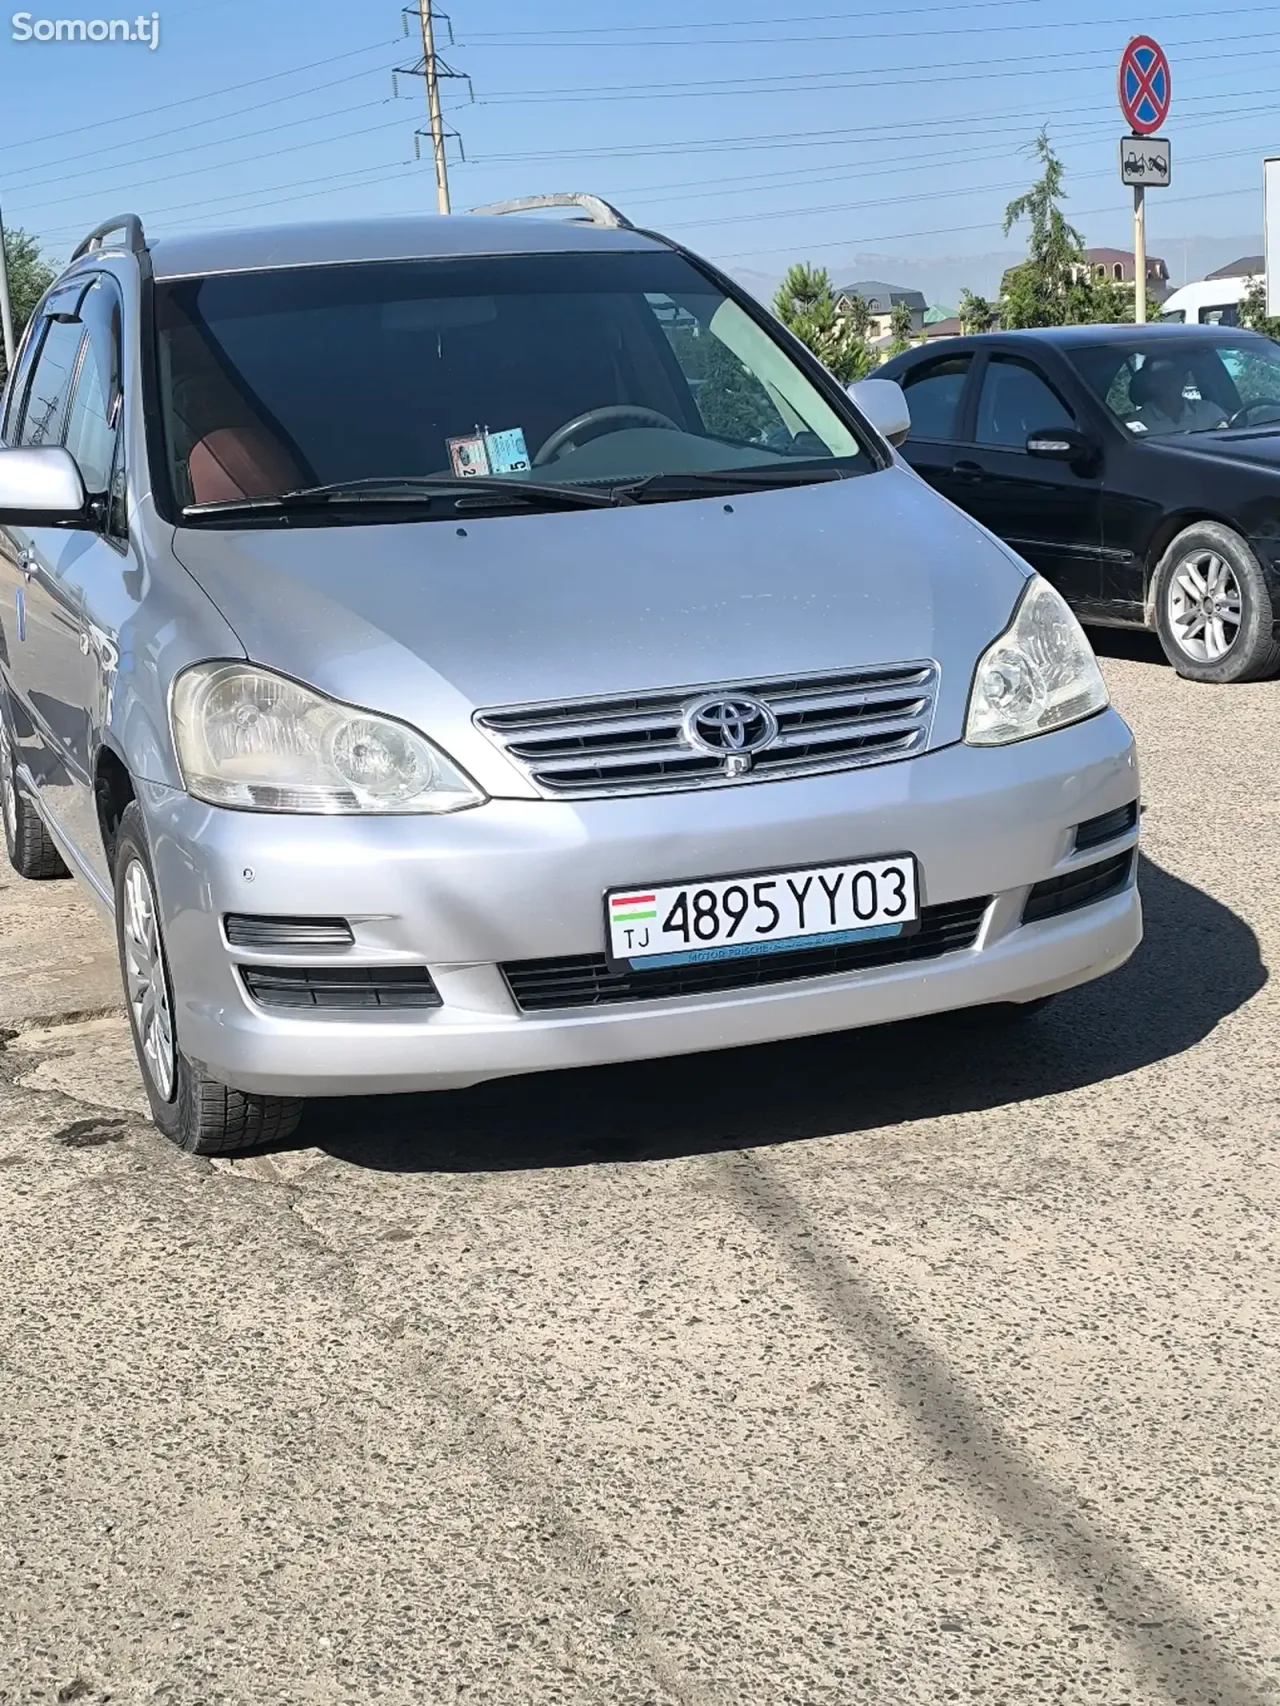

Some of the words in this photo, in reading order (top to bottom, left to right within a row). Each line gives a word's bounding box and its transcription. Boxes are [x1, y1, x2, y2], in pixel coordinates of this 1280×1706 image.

[510, 461, 527, 471] 5
[463, 468, 477, 476] 2
[623, 928, 650, 949] TJ
